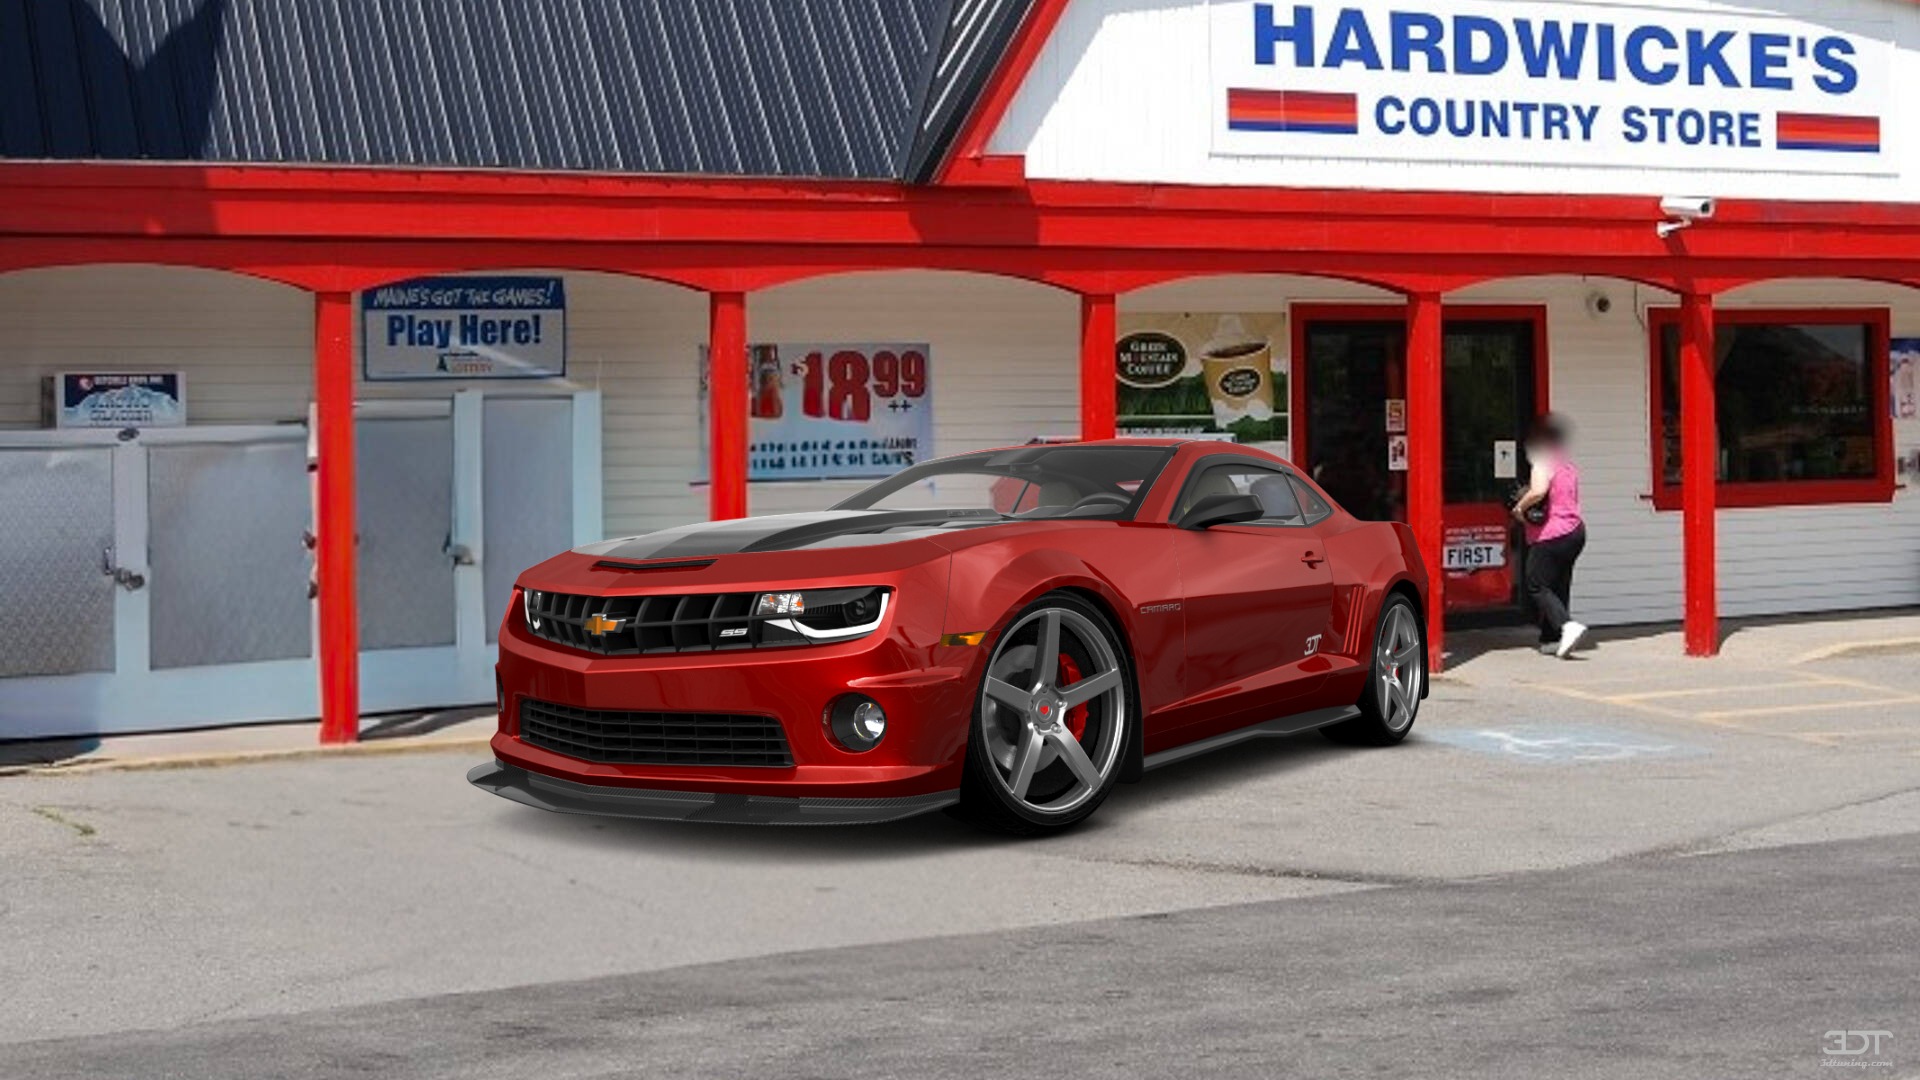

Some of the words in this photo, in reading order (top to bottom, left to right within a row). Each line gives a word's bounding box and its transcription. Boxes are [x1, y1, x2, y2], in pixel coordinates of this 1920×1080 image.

[1253, 3, 1859, 95] HARDWICKE'S
[1375, 96, 1600, 142] COUNTRY
[1622, 106, 1762, 148] STORE
[431, 288, 463, 306] GOT
[492, 281, 556, 305] GAMES!
[386, 314, 453, 349] Play
[459, 313, 541, 346] Here!
[1447, 546, 1493, 565] FIRST
[1140, 603, 1181, 614] CAMARO
[719, 628, 748, 637] SS
